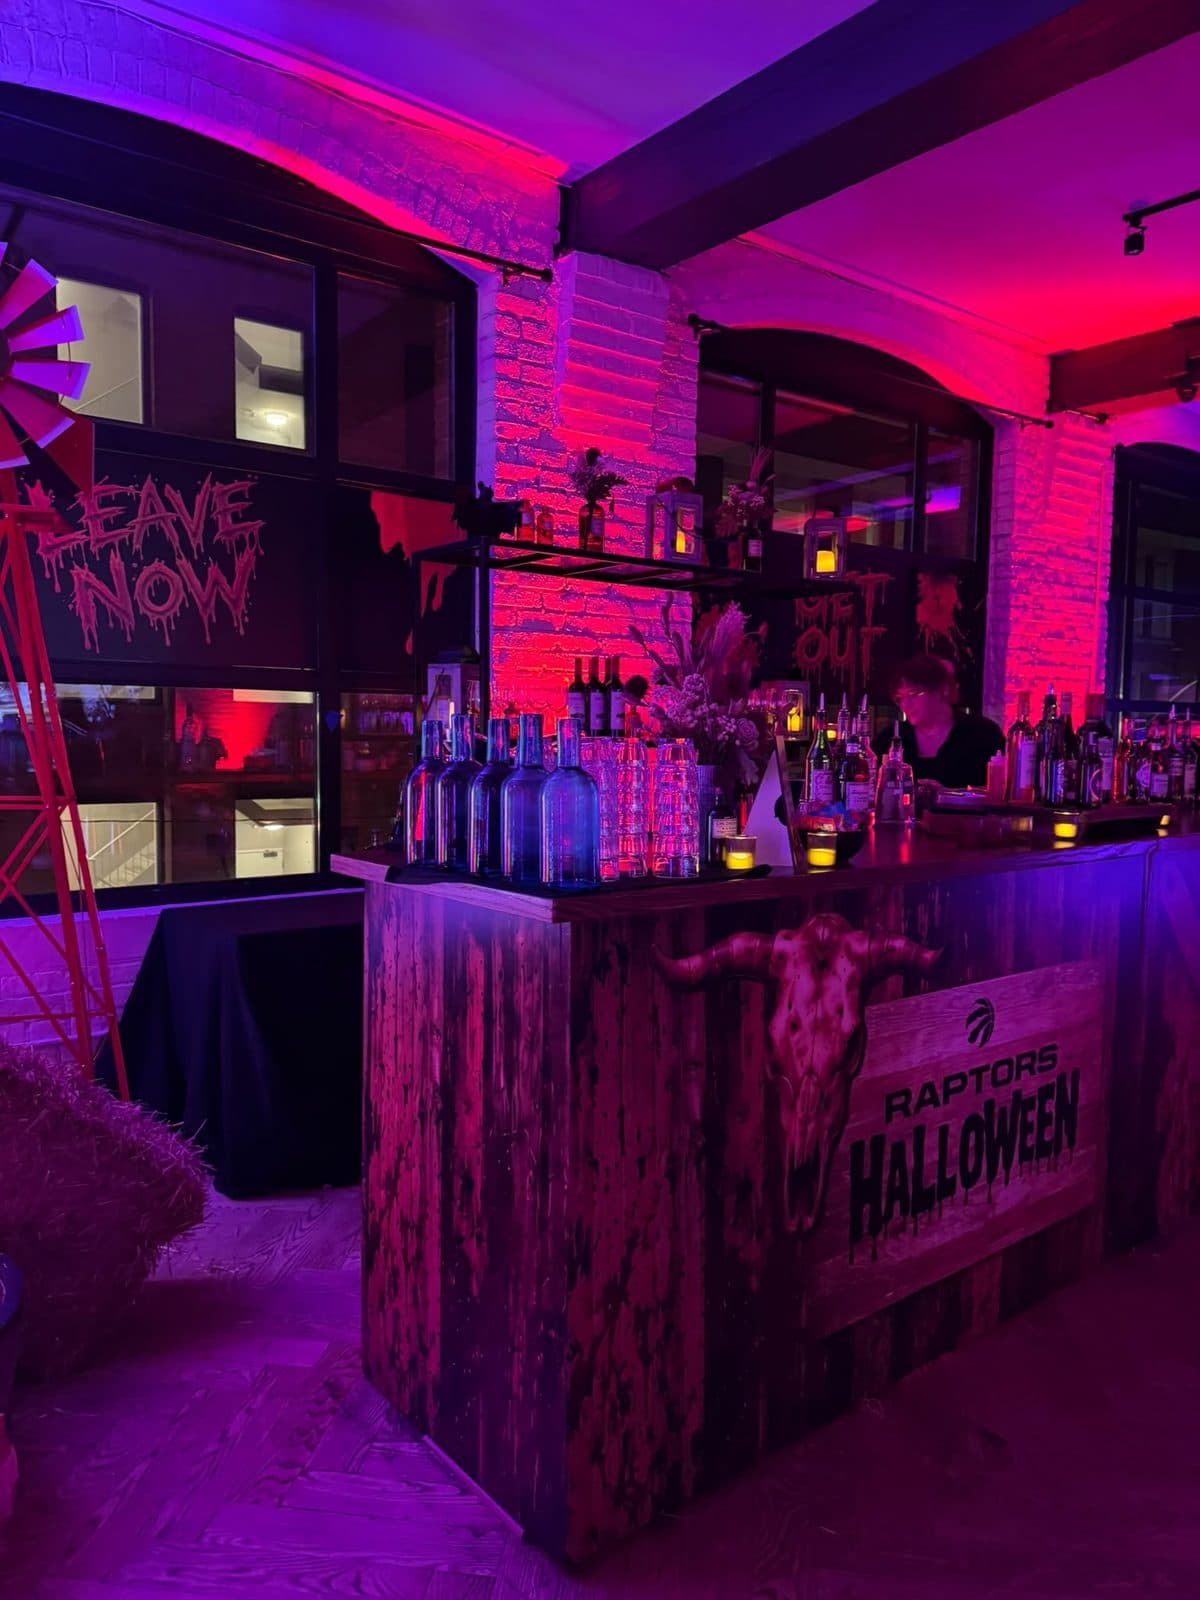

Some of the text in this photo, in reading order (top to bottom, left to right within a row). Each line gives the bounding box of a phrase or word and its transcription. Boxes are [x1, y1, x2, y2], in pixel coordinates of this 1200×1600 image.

[24, 472, 268, 592] LEAVE
[69, 549, 257, 653] NOW
[793, 625, 889, 688] OUT
[884, 1044, 1059, 1124] RAPTORS
[849, 1068, 1081, 1263] HALLOWEEN
